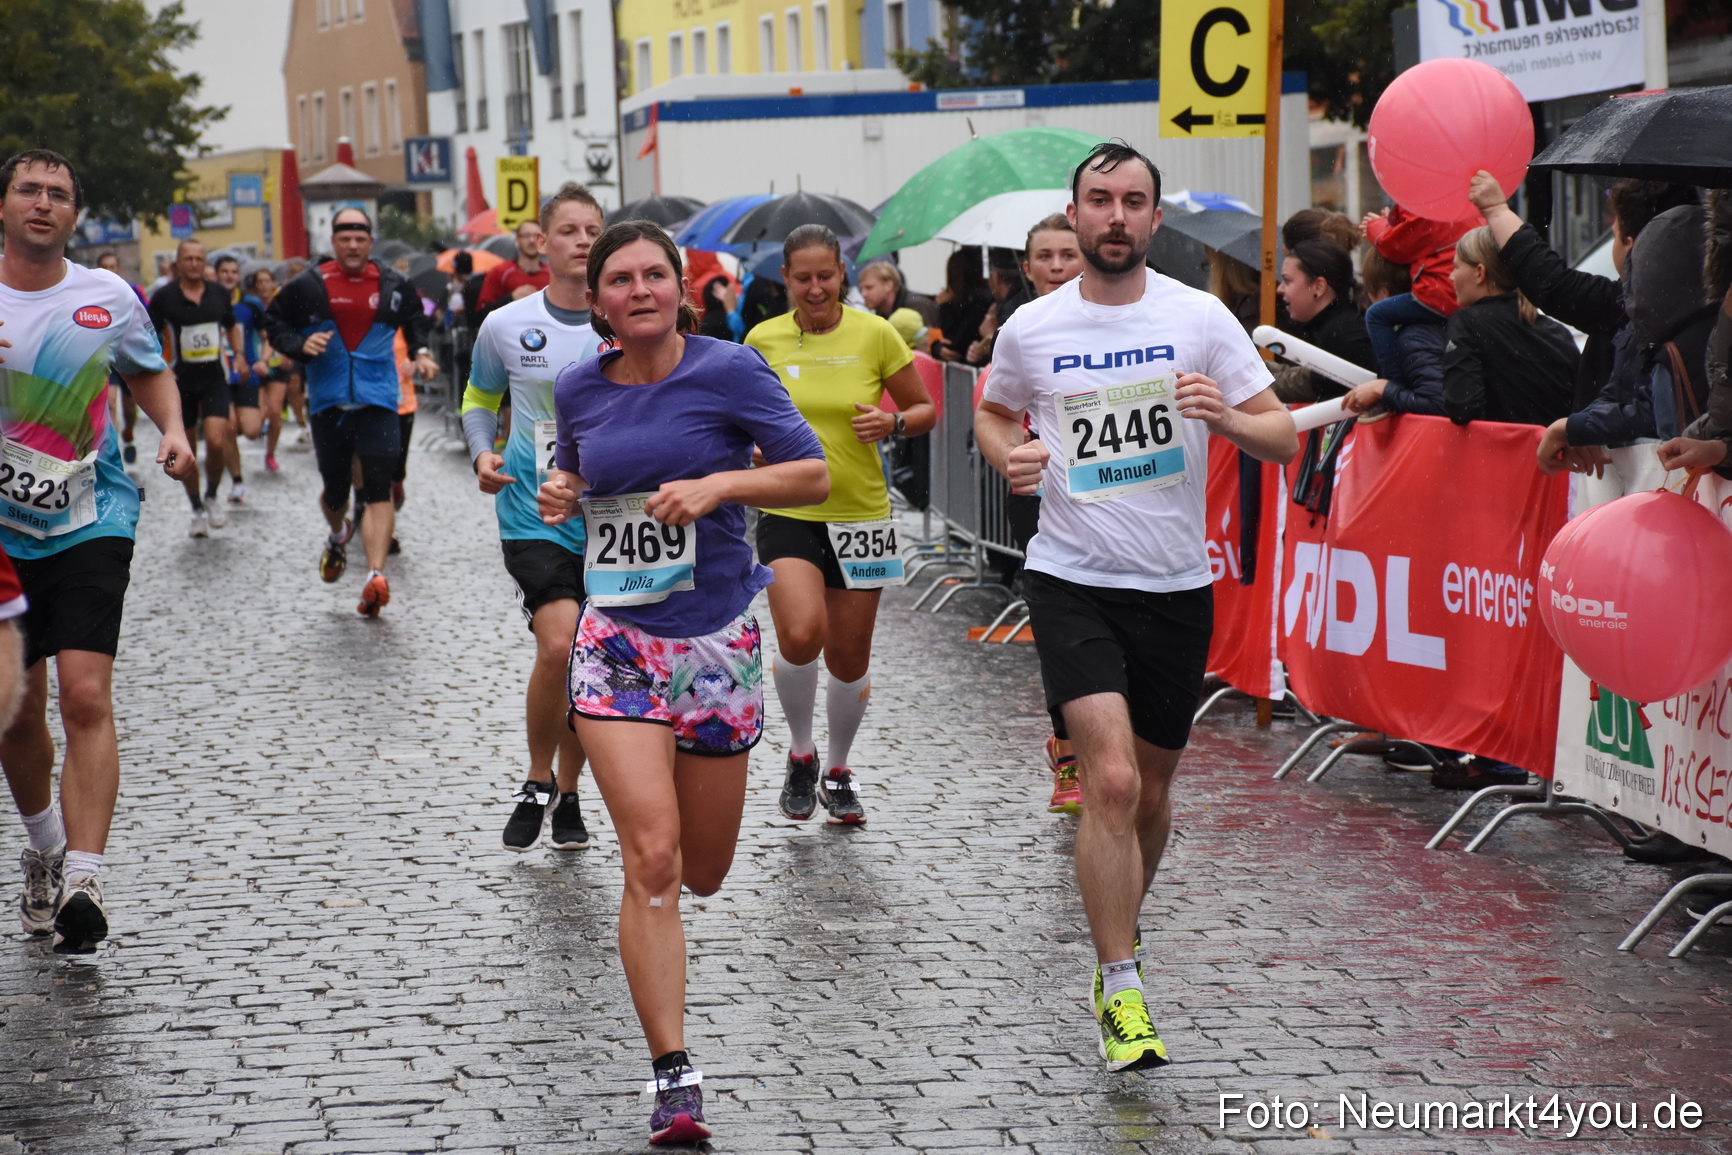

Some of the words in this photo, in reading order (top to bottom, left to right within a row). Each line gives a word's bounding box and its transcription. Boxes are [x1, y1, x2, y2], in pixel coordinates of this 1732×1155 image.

[1190, 6, 1251, 98] C
[508, 178, 529, 213] D
[192, 333, 210, 349] 55
[520, 355, 549, 363] PARTL
[1053, 344, 1175, 374] PUMA
[1106, 379, 1168, 403] BOCK
[1064, 400, 1102, 412] NeuerMarkt
[1071, 403, 1174, 460] 2446
[1097, 458, 1158, 485] Manuel
[0, 462, 70, 510] 2323
[7, 506, 49, 530] Stefan
[590, 507, 624, 517] NeuerMarkt
[596, 521, 686, 565] 2469
[836, 527, 898, 559] 2354
[619, 576, 655, 592] Julia
[851, 565, 886, 578] Andrea
